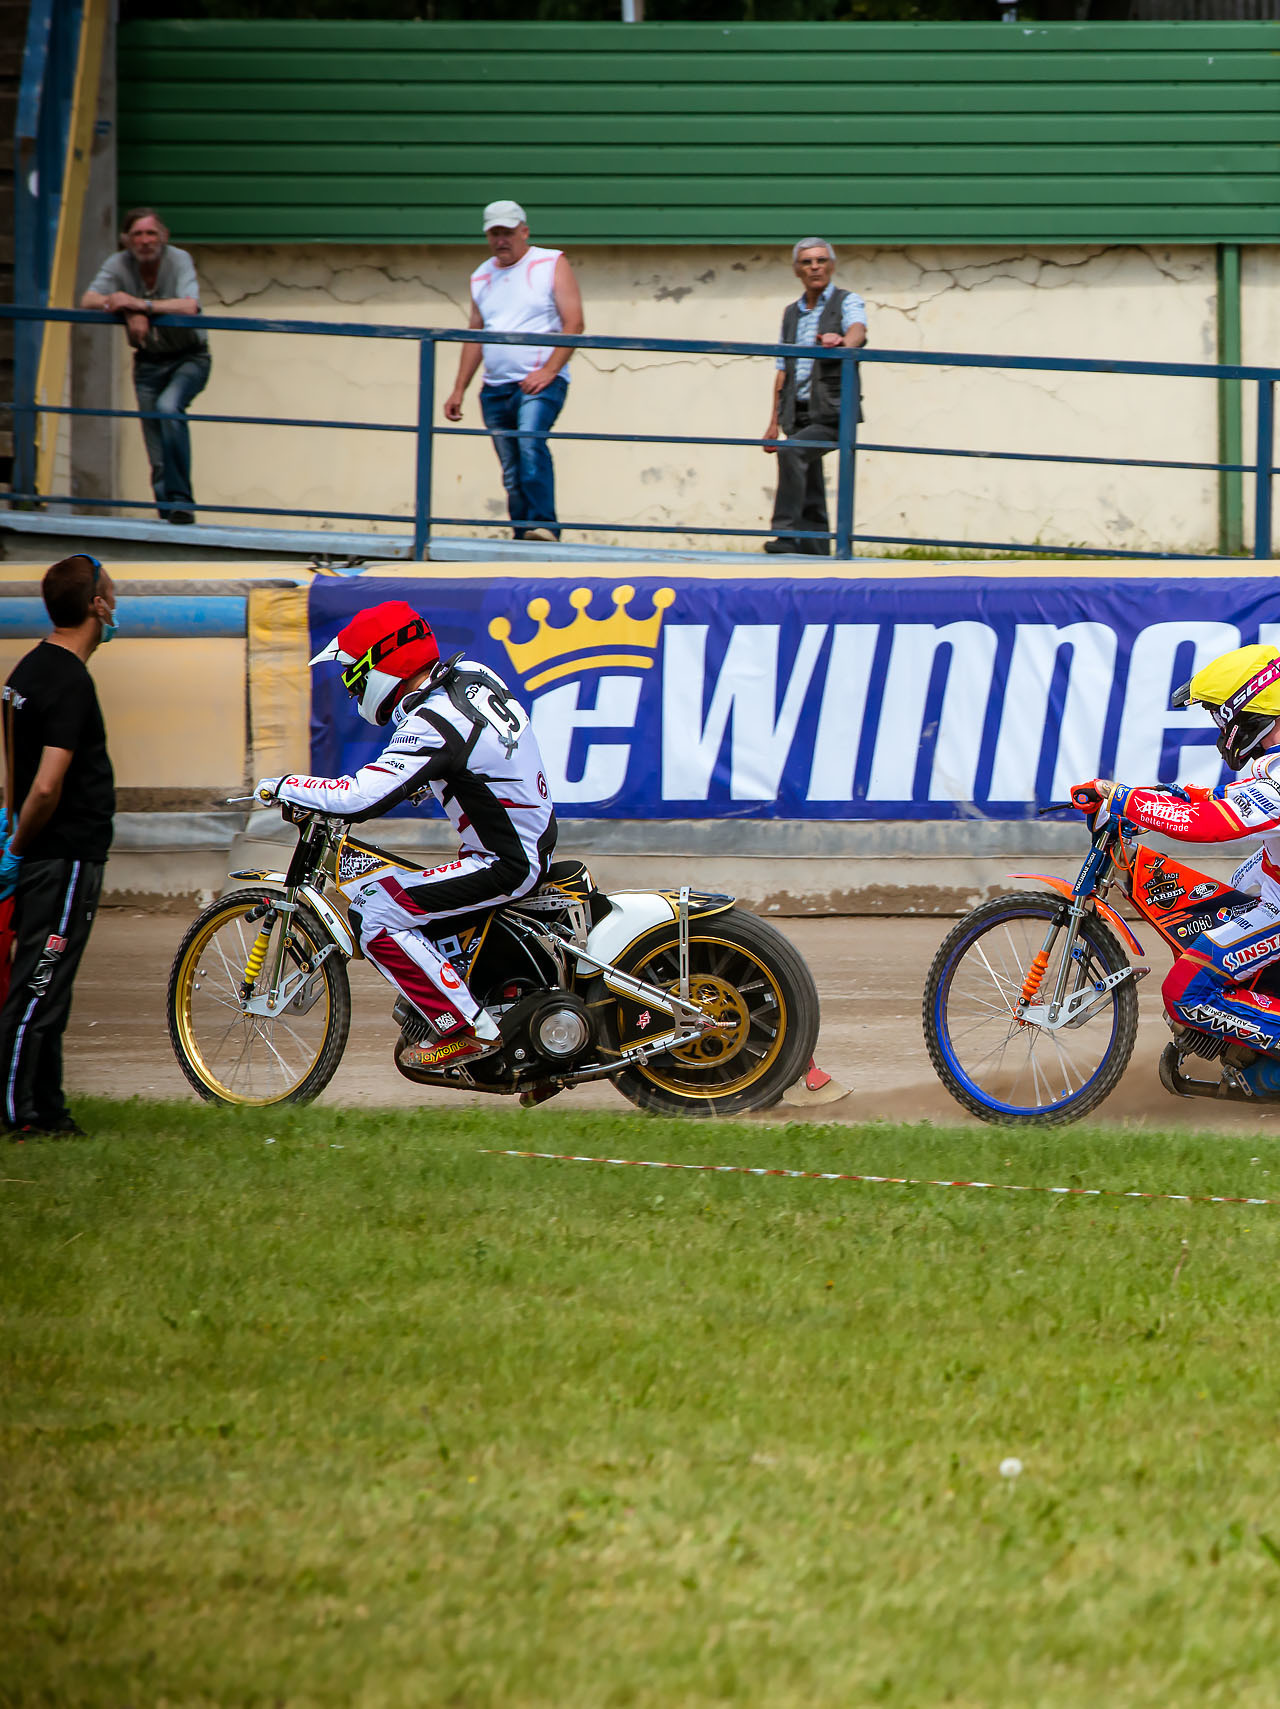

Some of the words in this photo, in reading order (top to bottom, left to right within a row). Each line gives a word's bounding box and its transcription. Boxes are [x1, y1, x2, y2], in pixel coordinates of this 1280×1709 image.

[487, 693, 521, 733] 9
[1140, 813, 1165, 828] better
[1166, 822, 1189, 832] trade
[1145, 887, 1186, 905] BARBER
[1203, 1004, 1248, 1028] AUTOKOMIS
